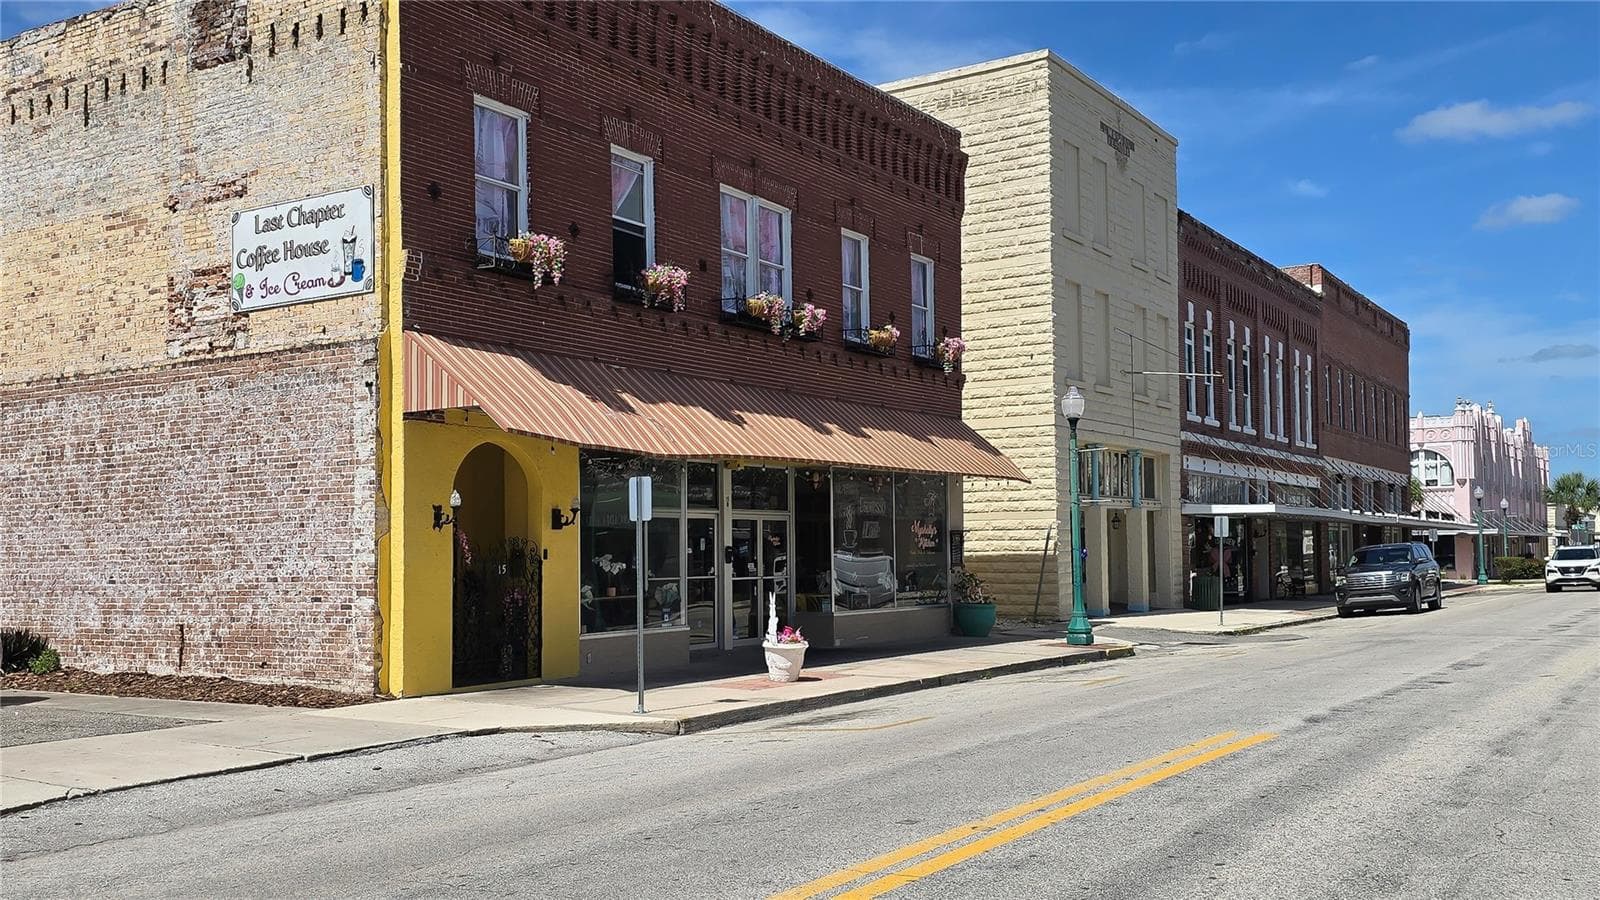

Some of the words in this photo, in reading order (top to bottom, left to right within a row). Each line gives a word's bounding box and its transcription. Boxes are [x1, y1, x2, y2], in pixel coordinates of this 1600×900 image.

[254, 214, 284, 235] Last
[286, 203, 346, 229] Chapter
[236, 245, 281, 272] Coffee
[282, 239, 331, 261] House
[245, 284, 255, 299] &
[259, 277, 282, 299] Ice
[283, 272, 327, 296] Cream
[498, 564, 507, 575] 15
